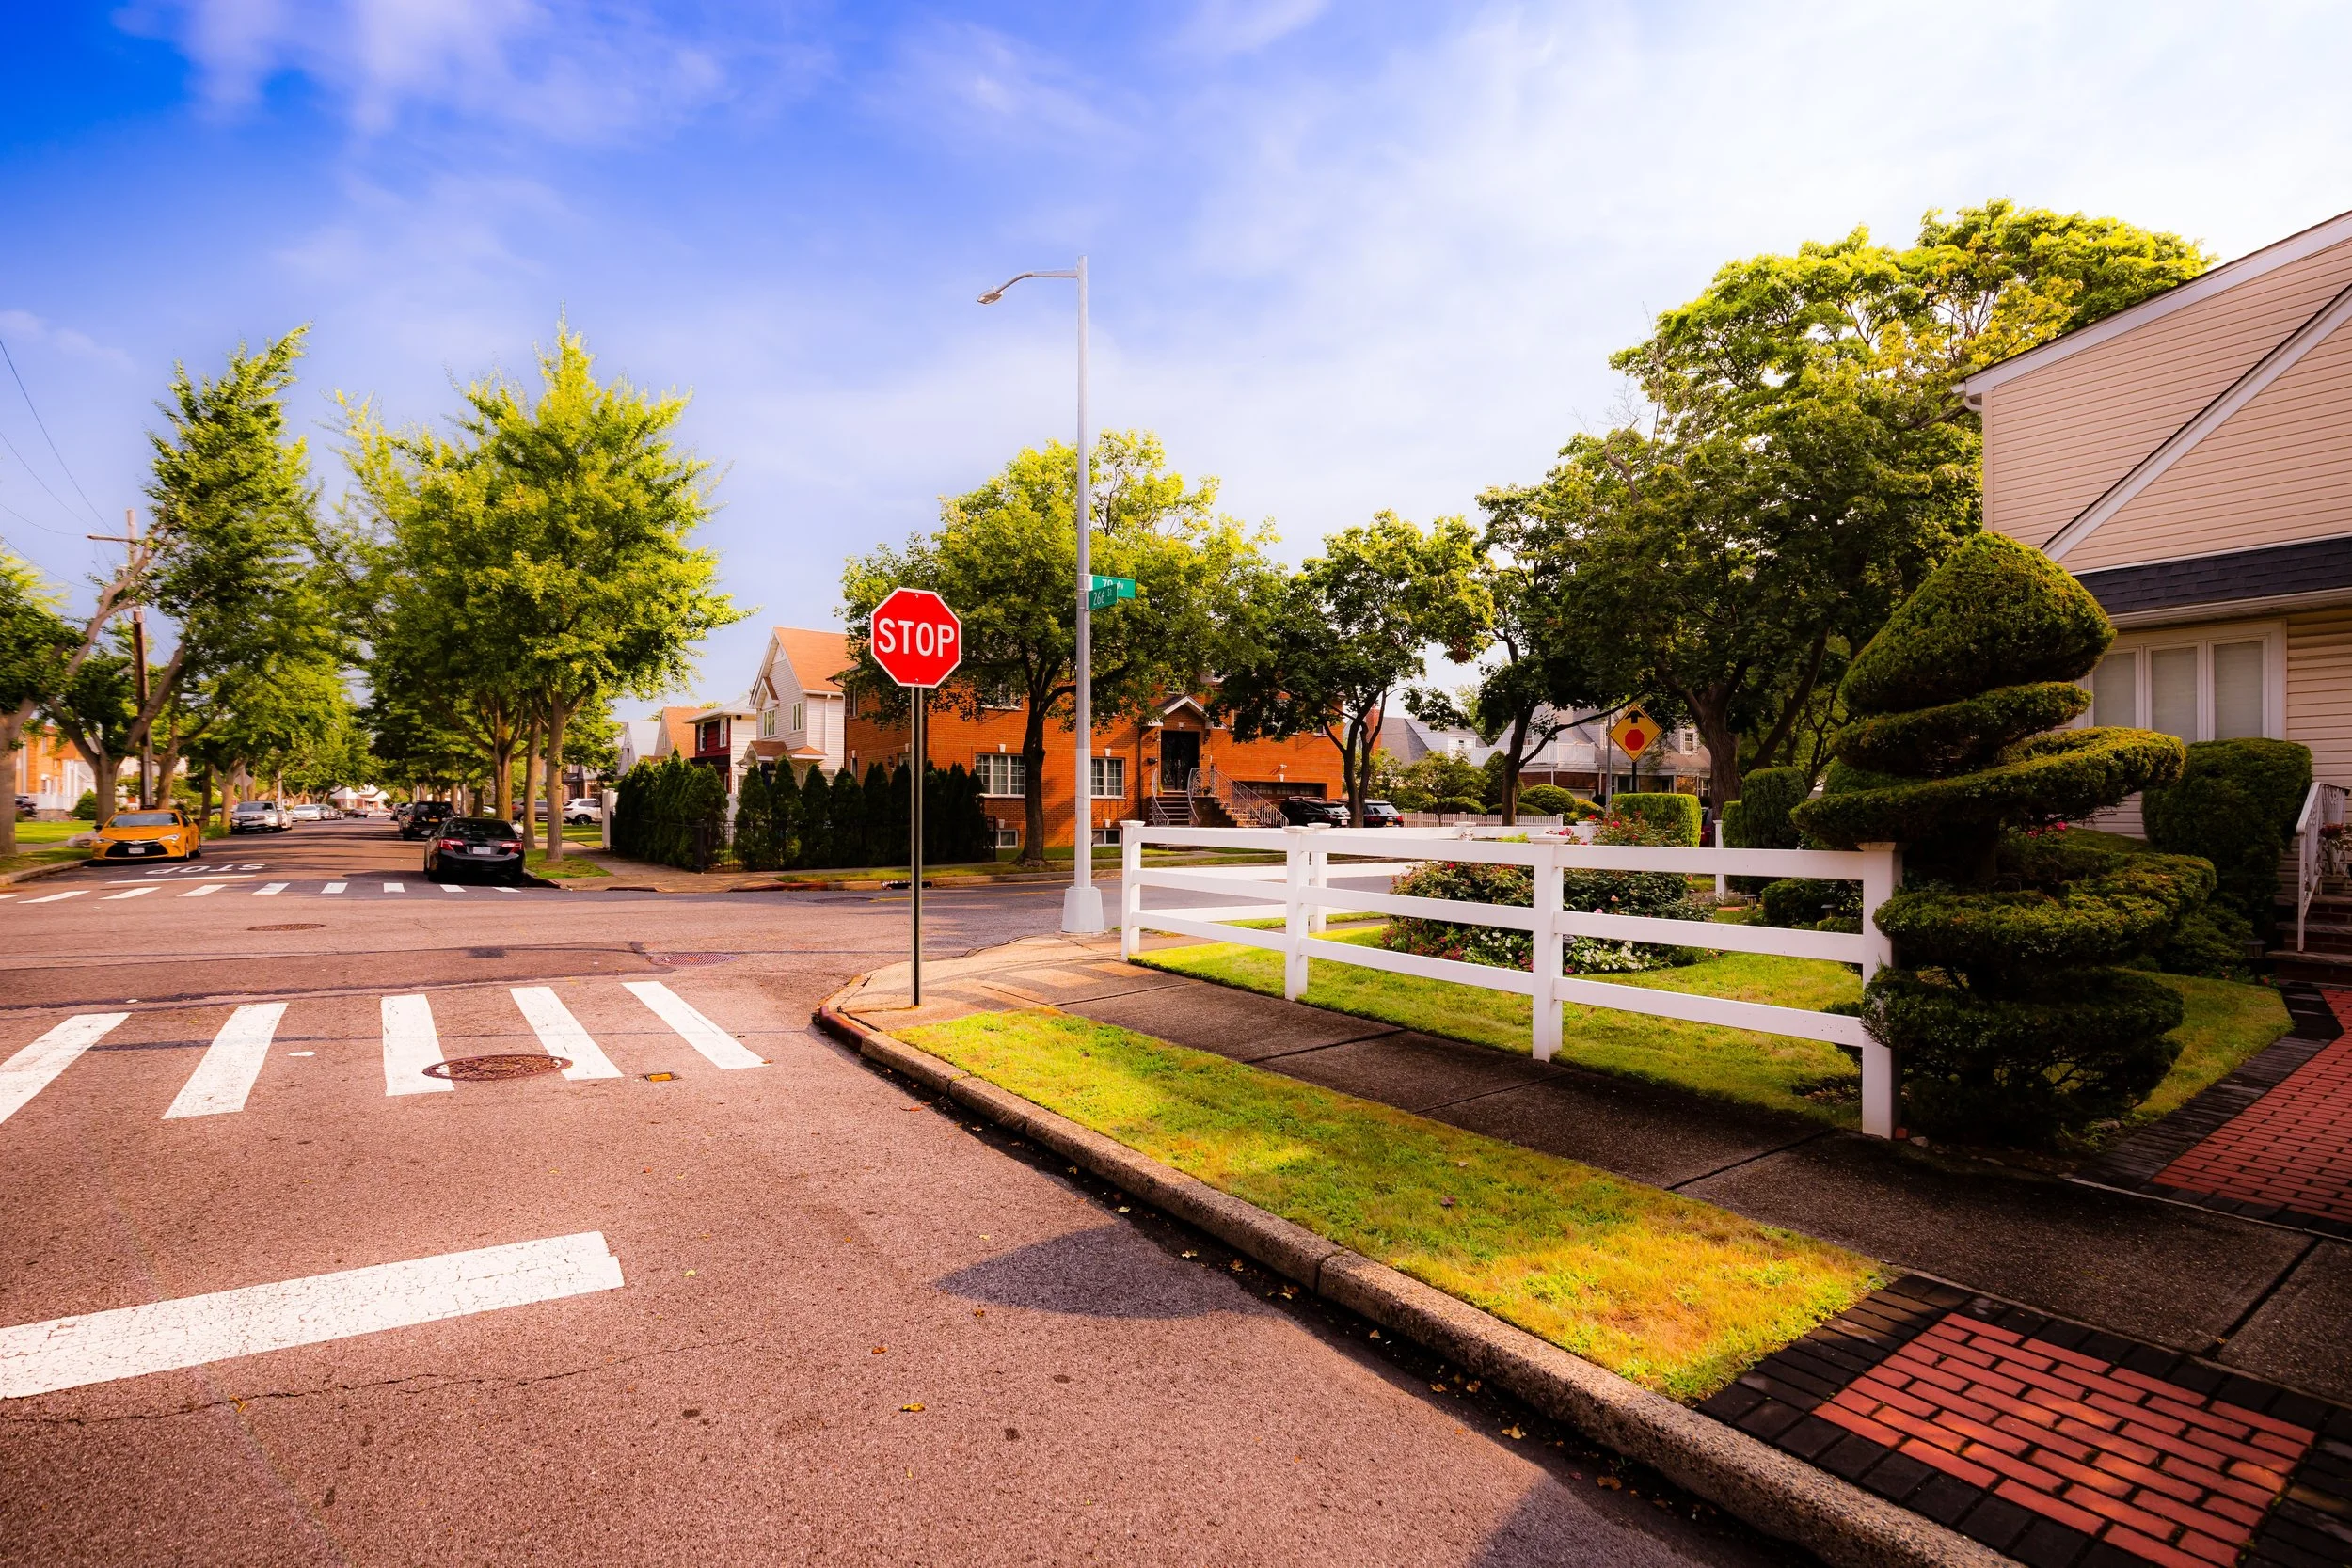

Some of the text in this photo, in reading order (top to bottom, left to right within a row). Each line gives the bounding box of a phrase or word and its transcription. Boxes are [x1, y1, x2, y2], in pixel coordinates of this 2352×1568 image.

[1093, 588, 1112, 605] 266 St
[878, 618, 955, 657] STOP
[145, 863, 266, 875] STOP
